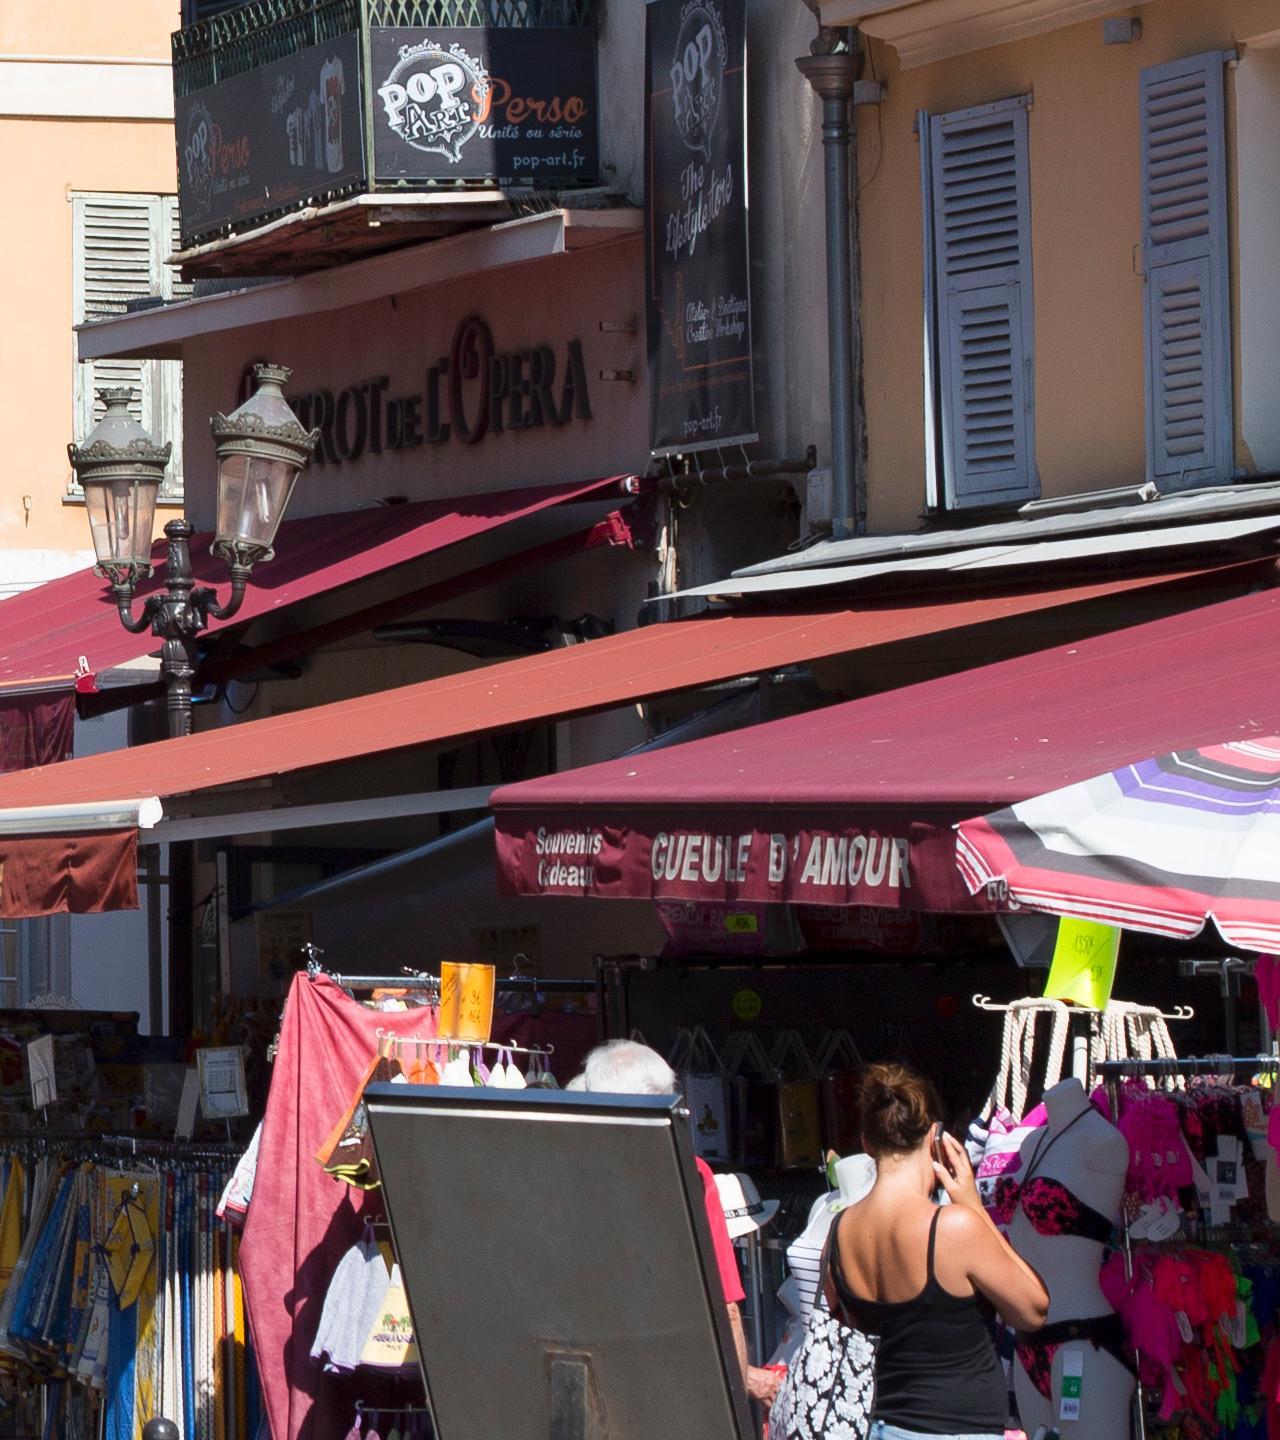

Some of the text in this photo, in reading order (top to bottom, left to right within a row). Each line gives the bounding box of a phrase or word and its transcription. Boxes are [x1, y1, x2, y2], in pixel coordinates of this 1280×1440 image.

[670, 24, 713, 115] POP
[377, 63, 466, 127] POP
[471, 78, 587, 124] Perso
[405, 102, 471, 152] ART
[478, 124, 584, 140] Unité ou série
[512, 148, 585, 170] pop-art.fr
[680, 160, 705, 201] The
[384, 393, 424, 450] DE
[682, 404, 723, 439] pop-art.fr
[534, 825, 604, 857] Souvenirs
[650, 833, 753, 883] GUEULE
